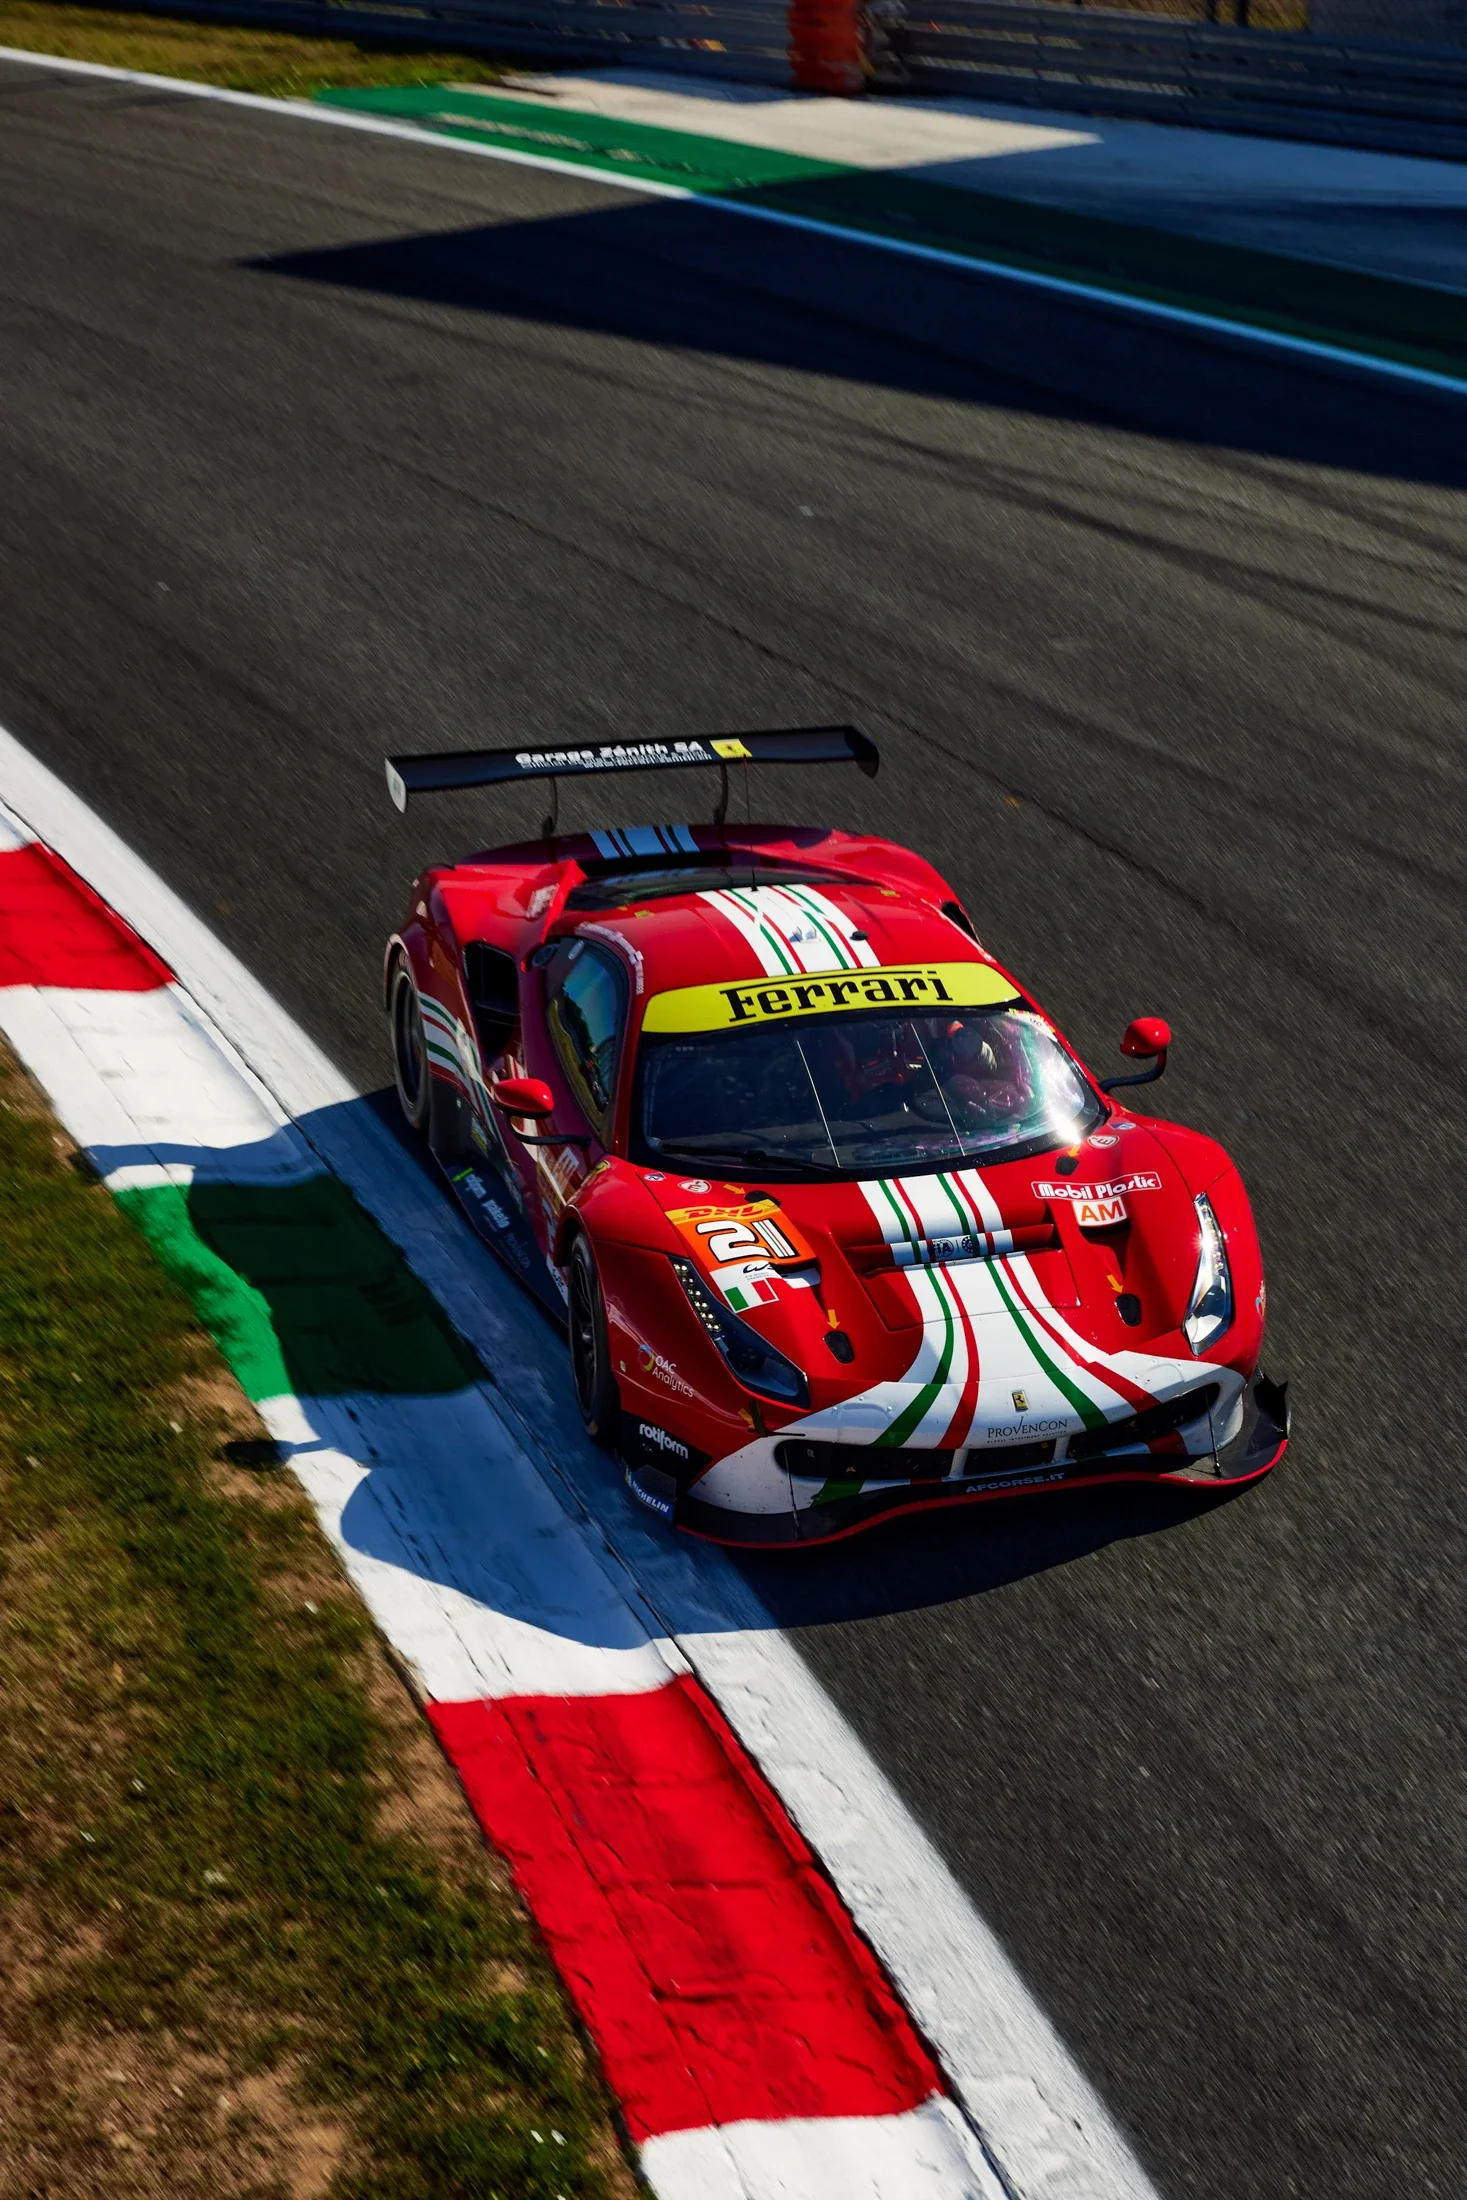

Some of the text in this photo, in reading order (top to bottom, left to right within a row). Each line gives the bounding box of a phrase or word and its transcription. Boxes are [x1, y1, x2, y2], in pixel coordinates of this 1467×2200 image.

[719, 971, 953, 1023] Ferrari
[1038, 1175, 1157, 1199] Mobil Plastic
[685, 1206, 763, 1219] DHL
[1081, 1200, 1124, 1222] AM
[696, 1218, 800, 1263] 21
[655, 1355, 677, 1375] OAC
[652, 1366, 694, 1398] Analytics
[639, 1423, 689, 1459] rotiform
[632, 1480, 669, 1513] MICHELIN
[965, 1472, 1065, 1493] AFCORSE.IT
